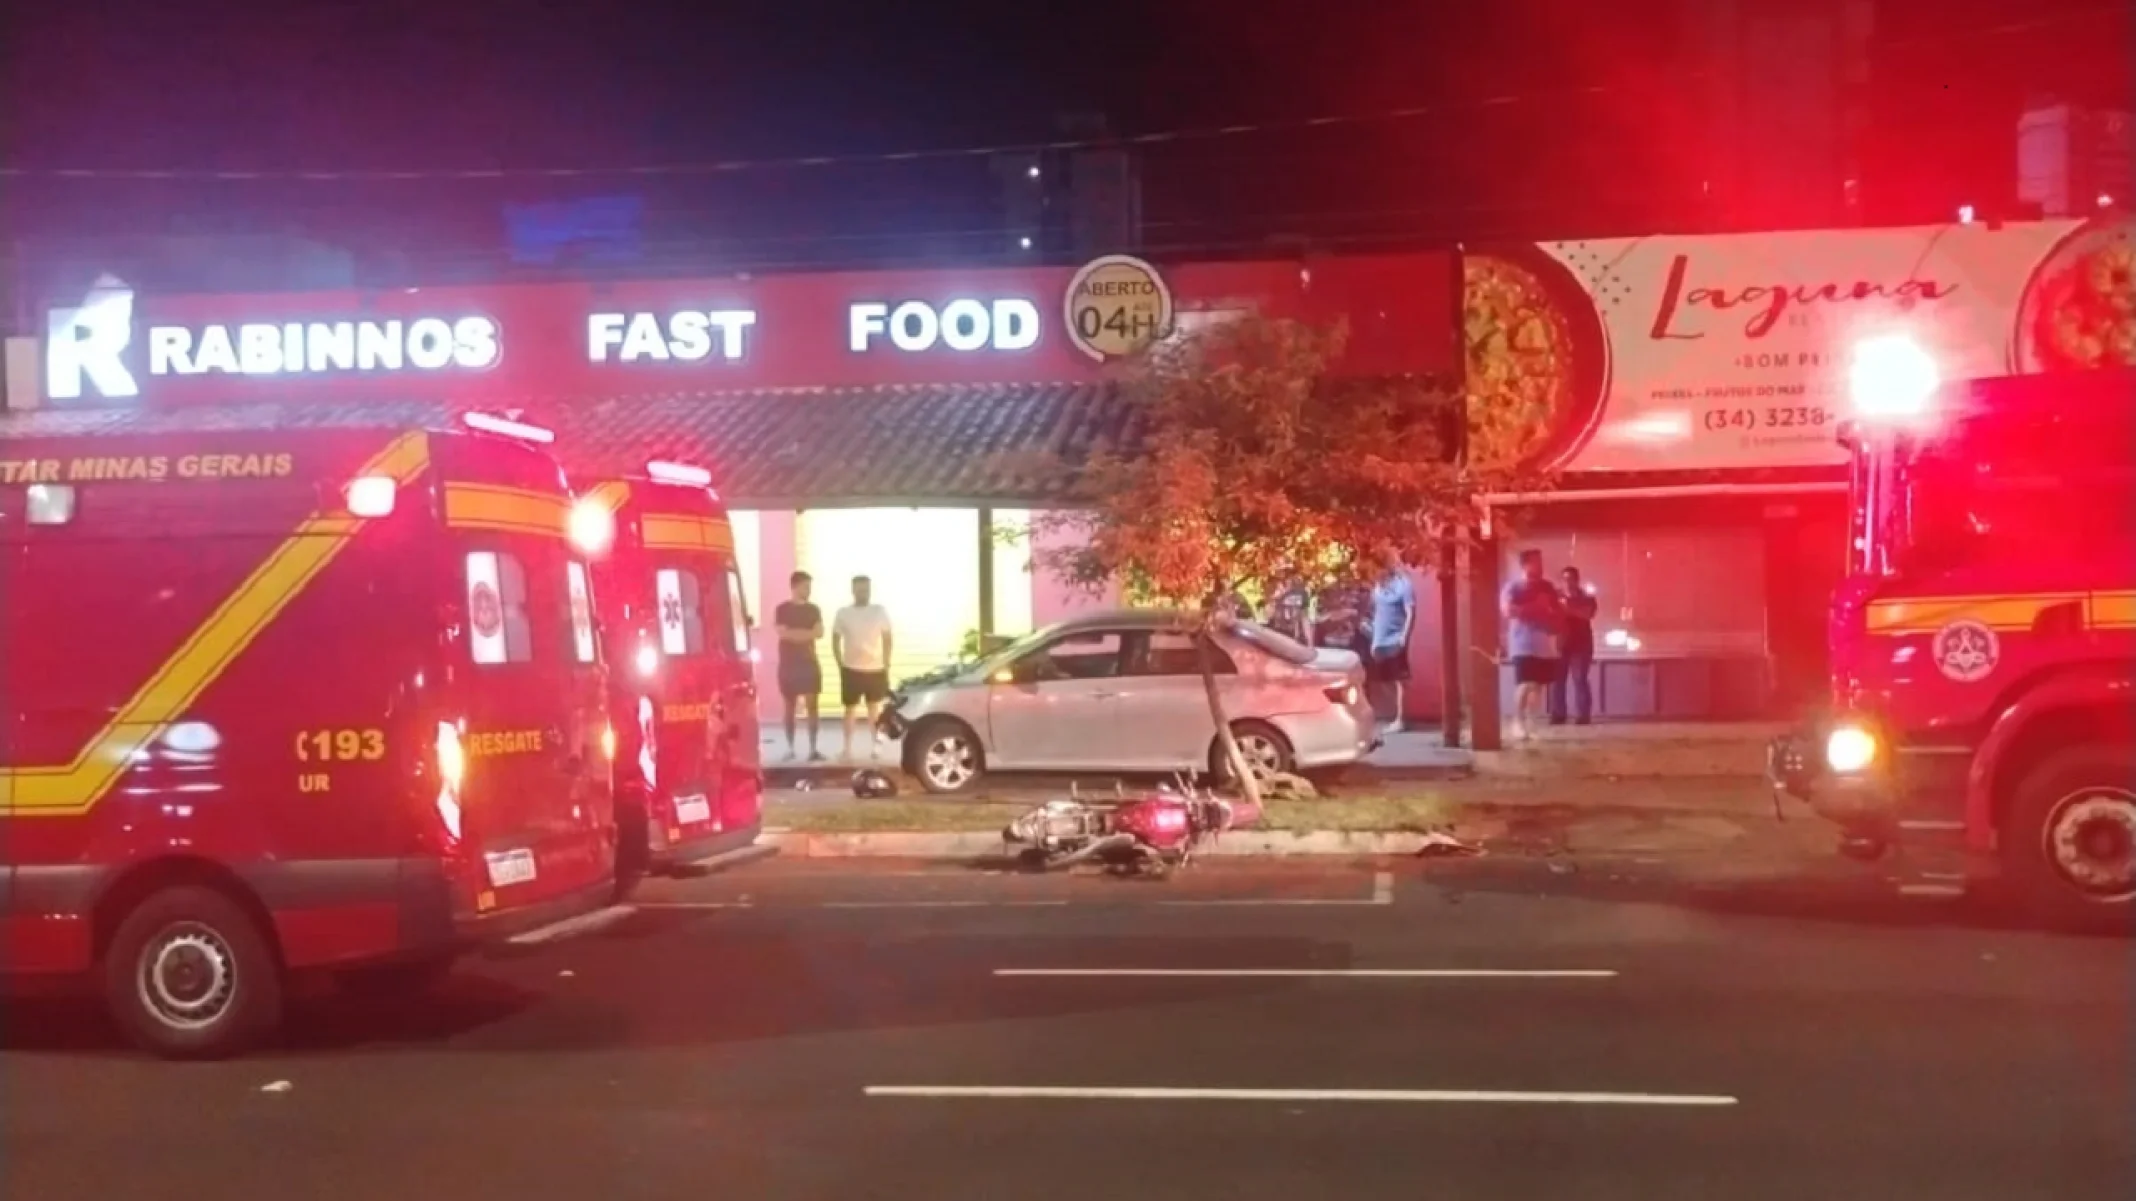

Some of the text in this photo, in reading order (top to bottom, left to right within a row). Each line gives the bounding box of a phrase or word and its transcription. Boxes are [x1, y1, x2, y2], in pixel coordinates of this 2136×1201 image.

[1077, 281, 1154, 296] ABERTO
[1650, 254, 1959, 340] Laguna
[1078, 306, 1154, 338] 04H
[149, 299, 1040, 375] RABINNOS FAST FOOD
[1704, 409, 1756, 431] (34)
[69, 456, 168, 480] MINAS
[177, 453, 293, 477] GERAIS
[469, 730, 542, 756] RESGATE
[299, 773, 331, 793] UR
